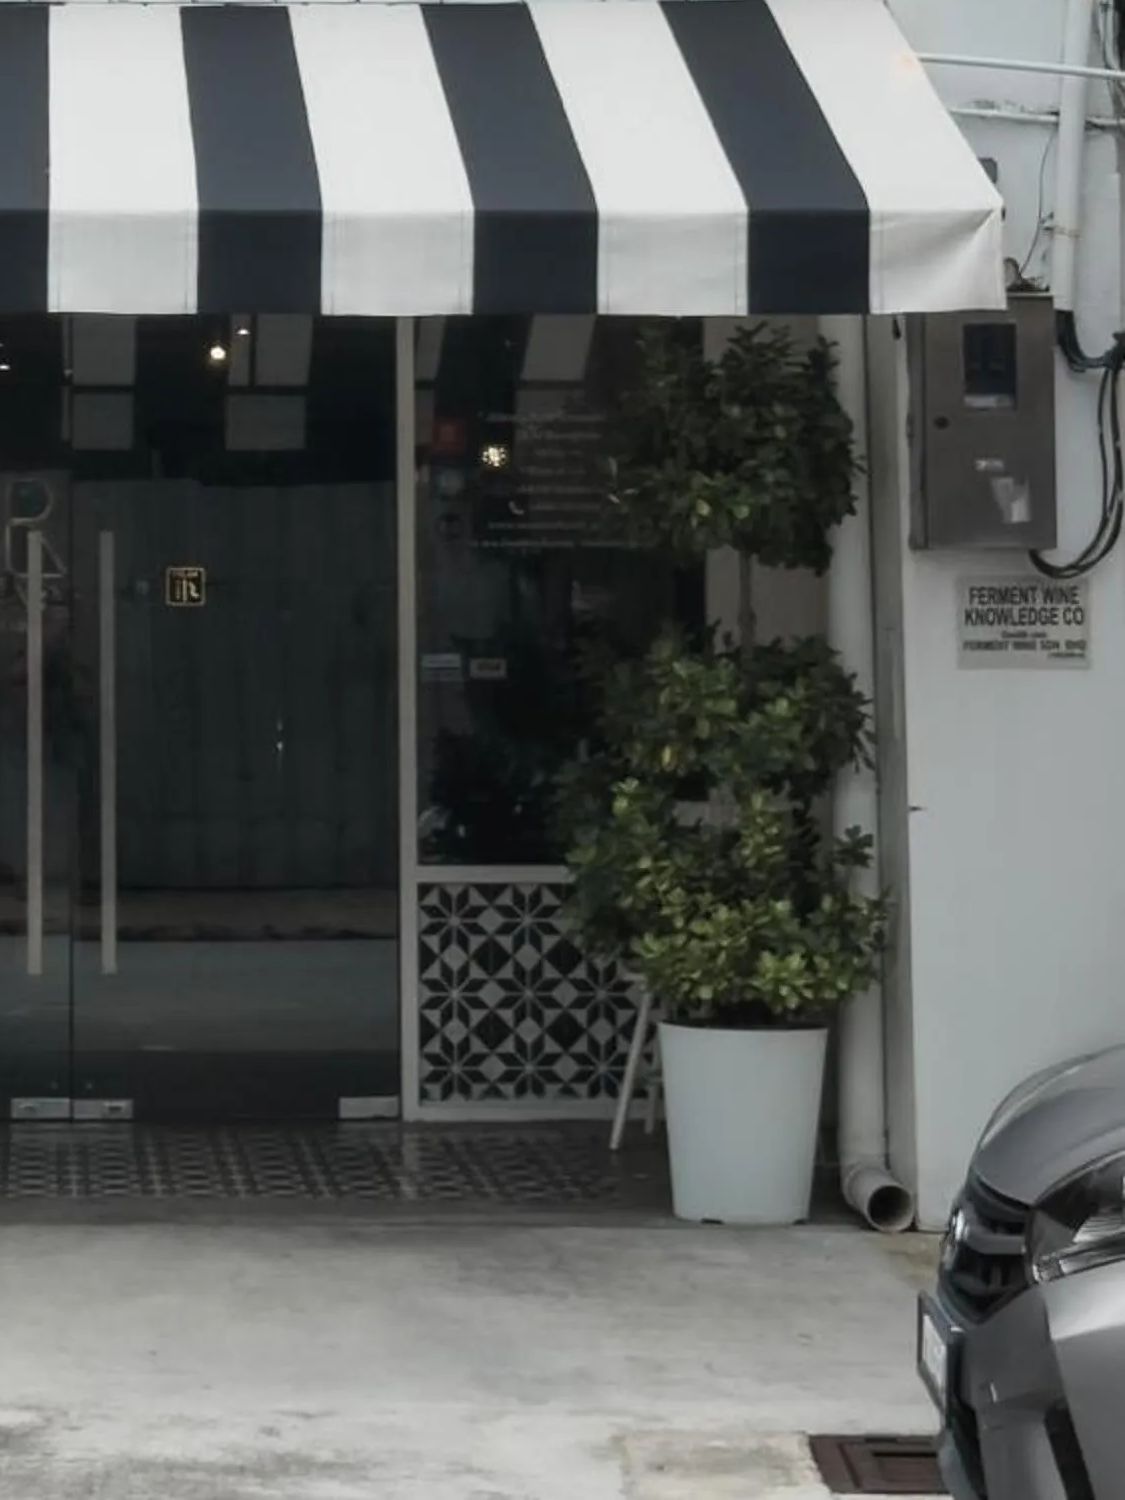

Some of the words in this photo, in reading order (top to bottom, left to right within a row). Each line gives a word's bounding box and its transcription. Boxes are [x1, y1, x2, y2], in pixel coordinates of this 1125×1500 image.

[969, 586, 1037, 605] FERMENT
[1043, 586, 1080, 605] WINE
[964, 607, 1059, 626] KNOWLEDGE
[1062, 607, 1084, 626] CO
